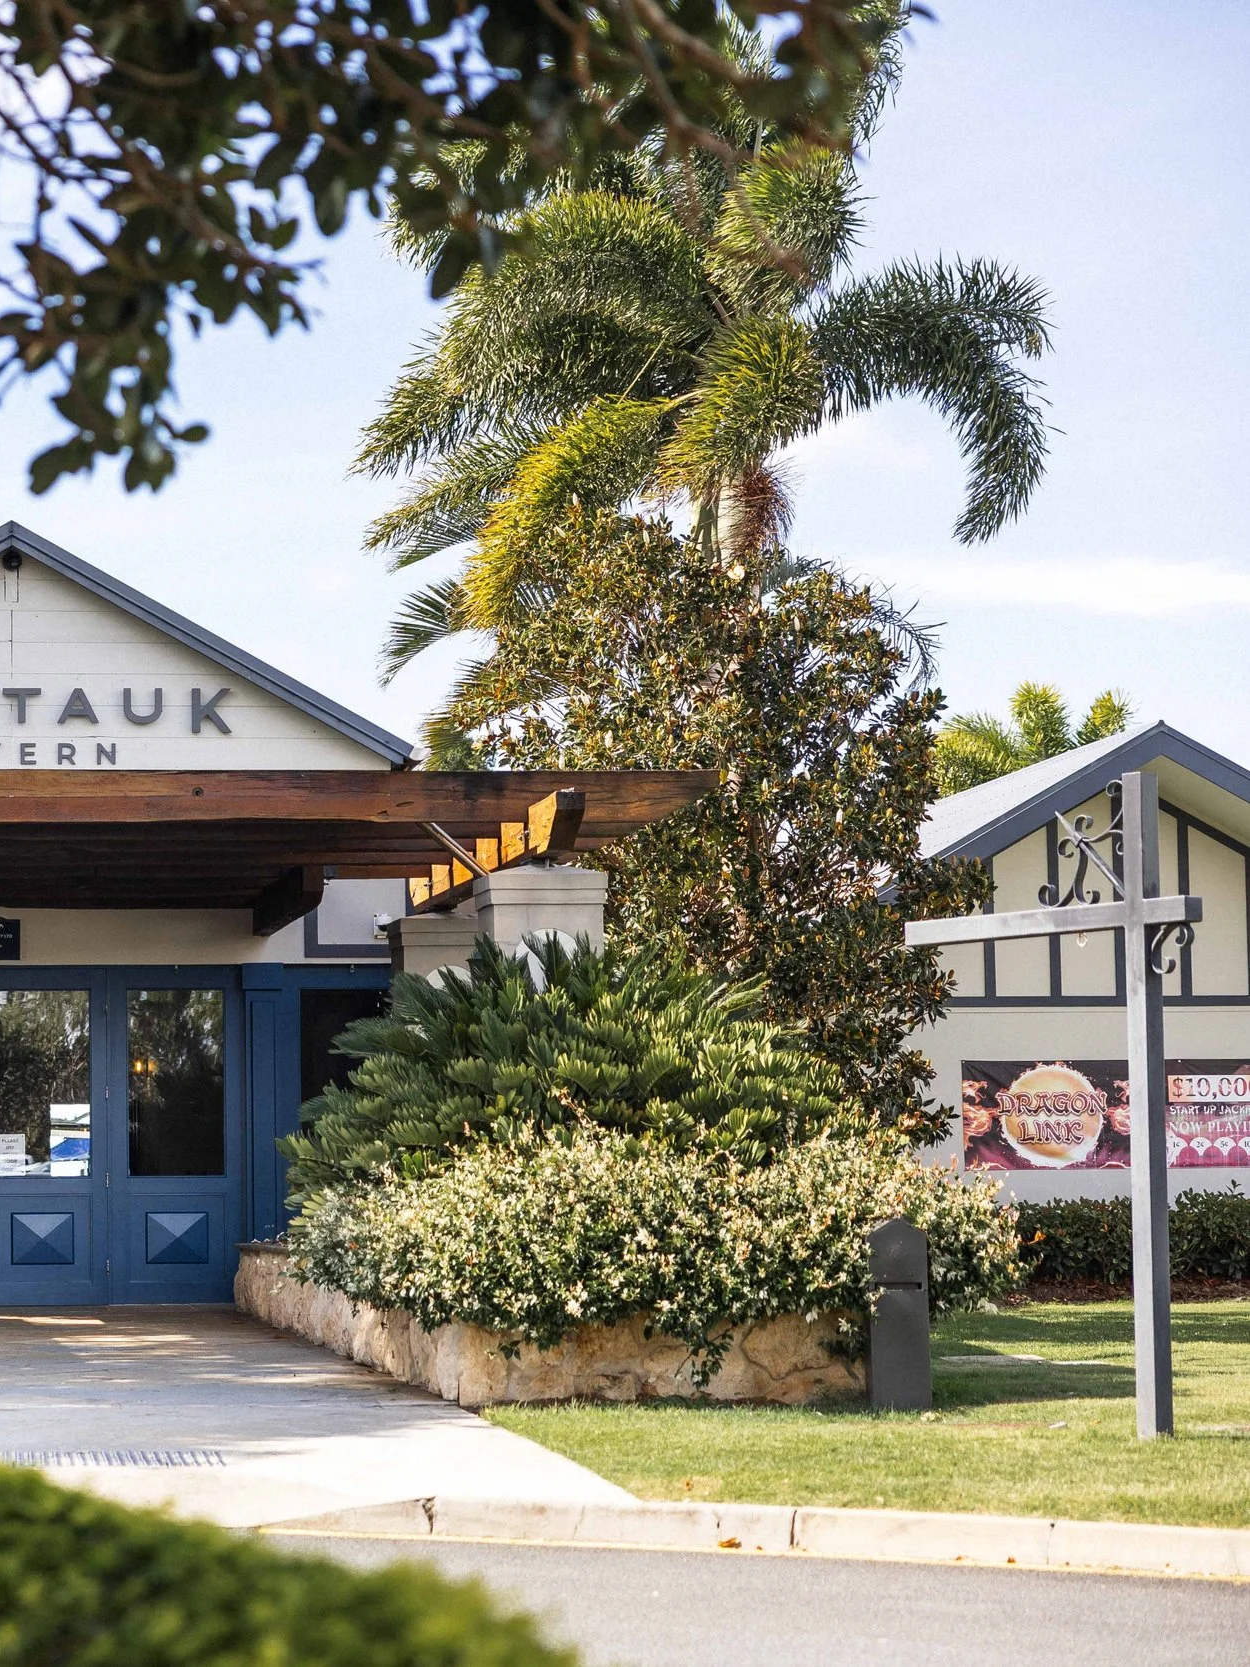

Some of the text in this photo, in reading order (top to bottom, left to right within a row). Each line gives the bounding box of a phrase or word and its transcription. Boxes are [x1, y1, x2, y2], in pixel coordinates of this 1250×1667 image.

[1172, 1076, 1250, 1099] $10,00
[995, 1091, 1108, 1116] DRAGON
[1169, 1105, 1200, 1115] START
[1203, 1105, 1217, 1114] UP
[1017, 1120, 1084, 1145] LINK
[1169, 1122, 1203, 1132] NOW
